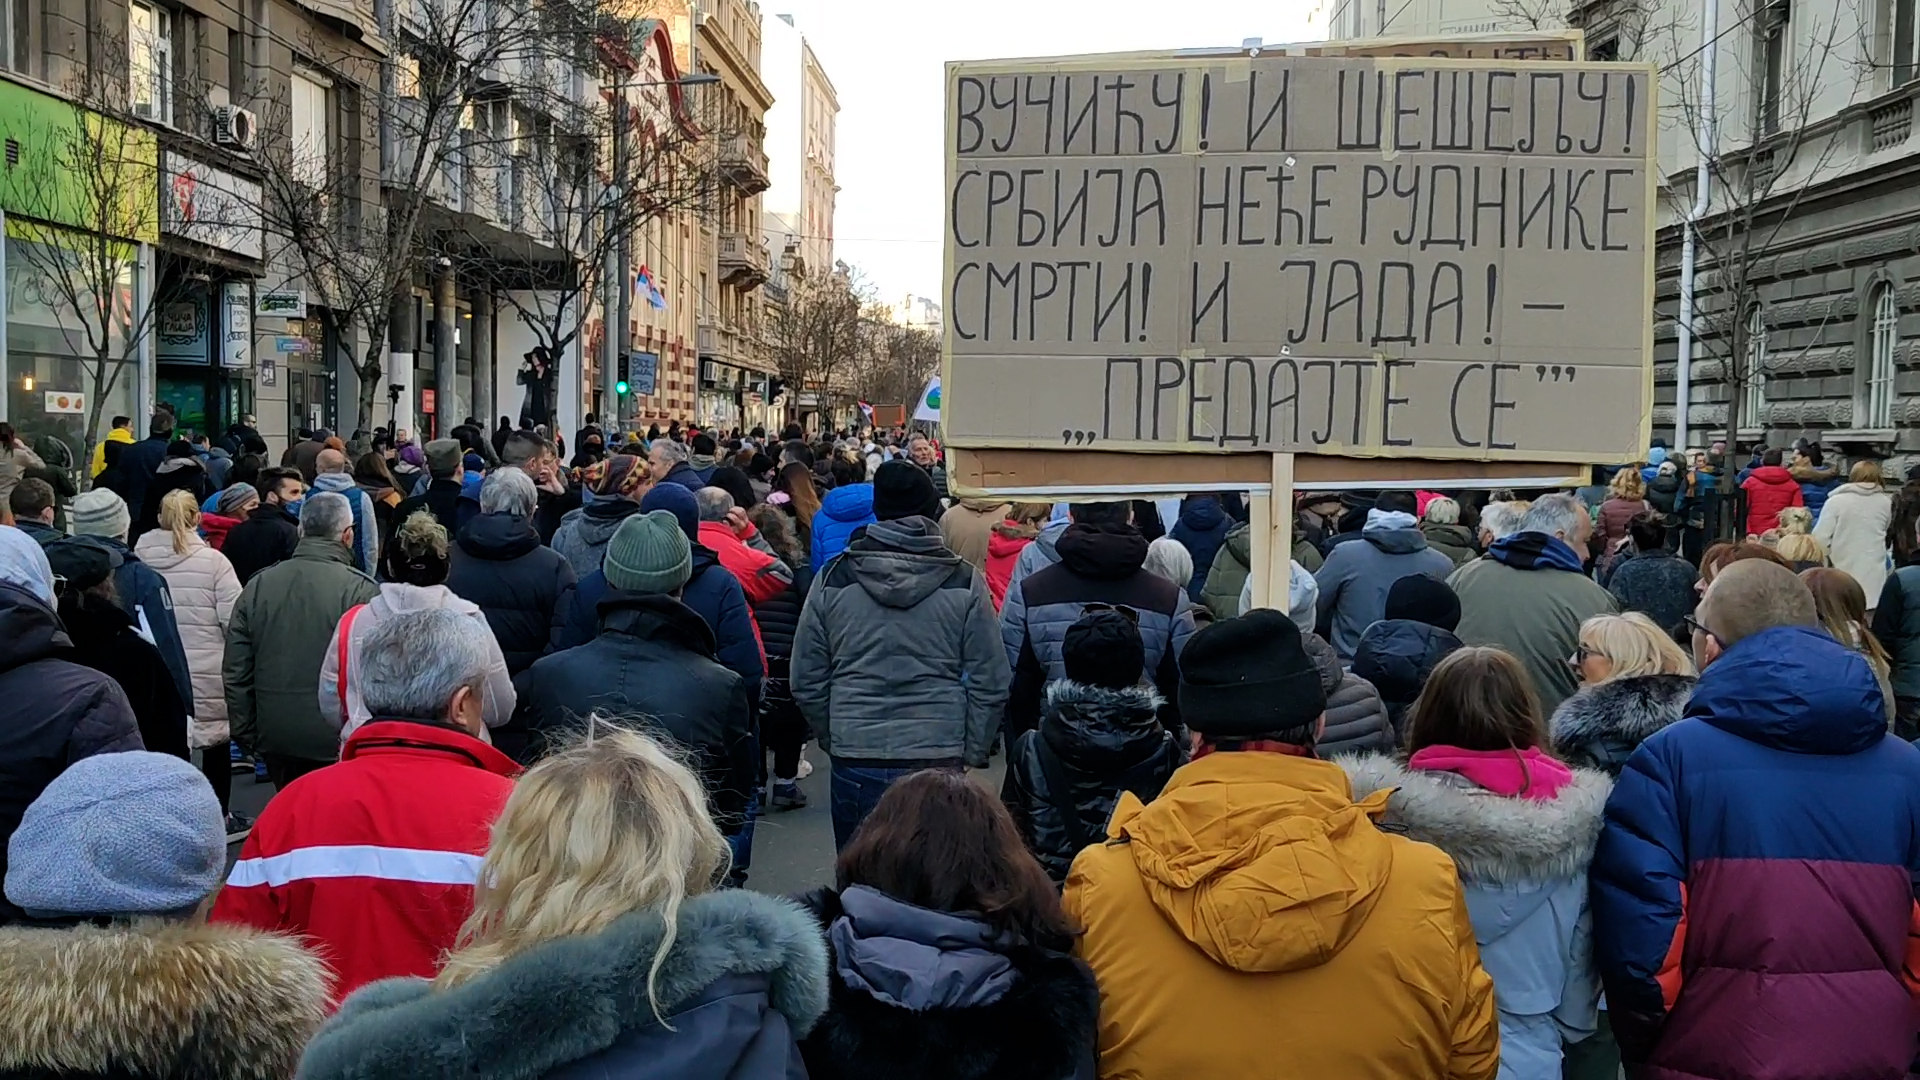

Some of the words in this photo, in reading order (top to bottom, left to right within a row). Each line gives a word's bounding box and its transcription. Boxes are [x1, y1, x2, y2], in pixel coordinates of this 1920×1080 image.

[957, 74, 1210, 154] ВУЧИЋУ!
[1247, 70, 1288, 151] И
[1337, 71, 1634, 153] ШЕШЕЉУ!
[952, 168, 1165, 247] СРБИЈА
[1197, 166, 1336, 245] НЕЋЕ
[1361, 165, 1633, 250] РУДНИКЕ
[953, 262, 1151, 342] СМРТИ!
[1191, 262, 1229, 343] И
[1280, 260, 1496, 346] ЈАДА!
